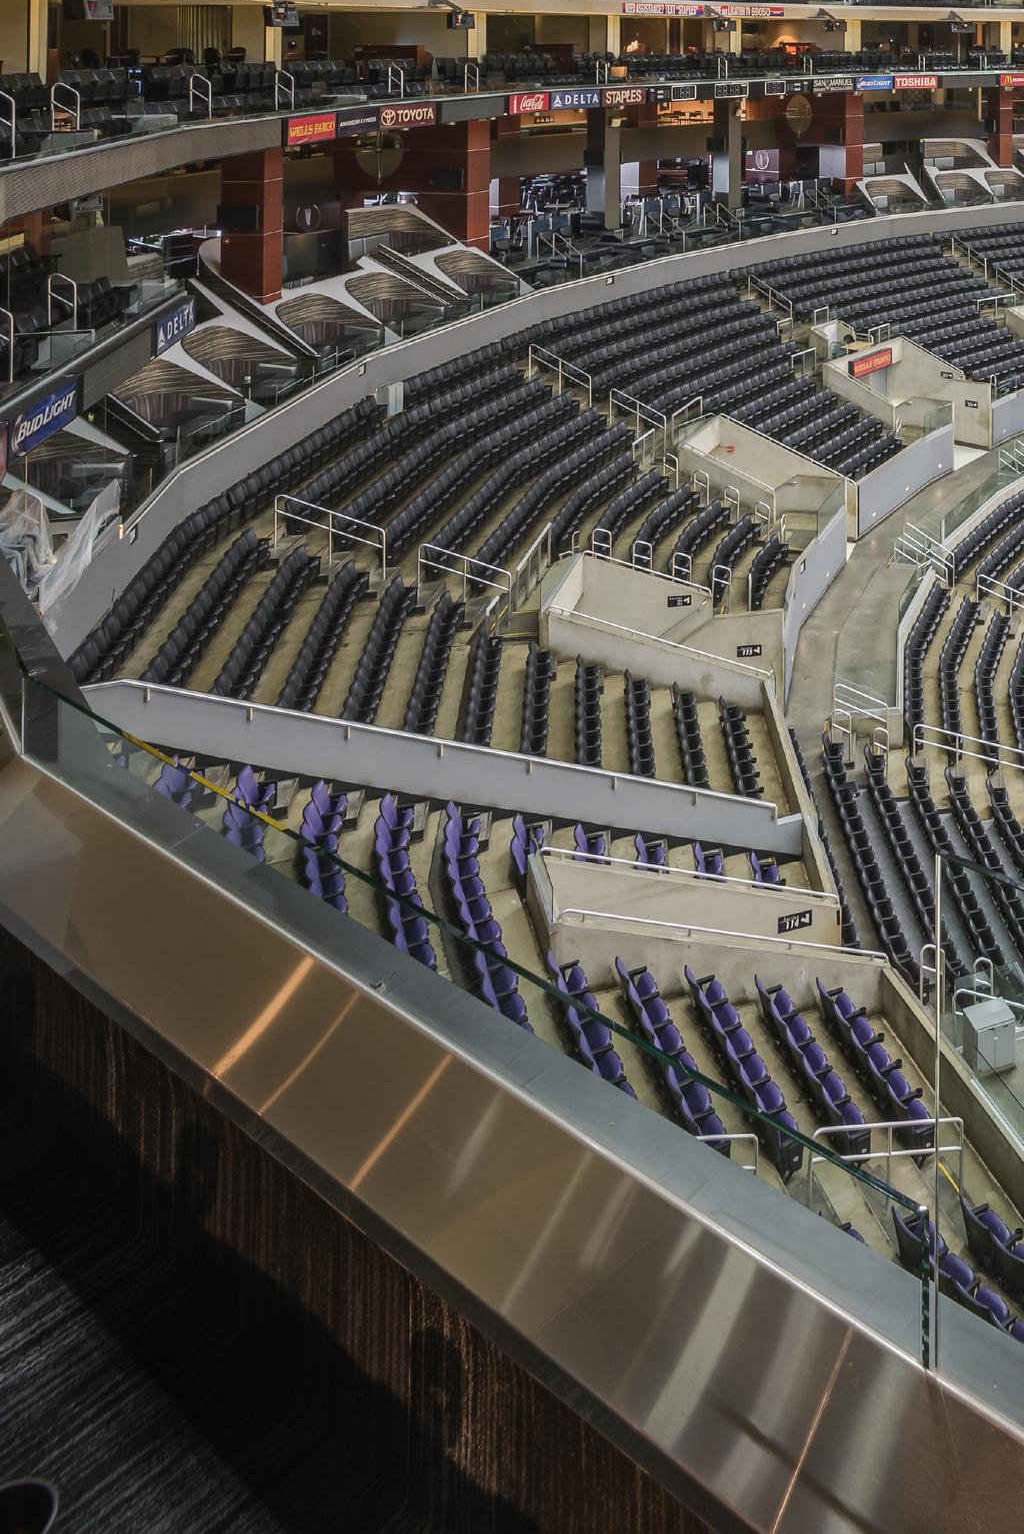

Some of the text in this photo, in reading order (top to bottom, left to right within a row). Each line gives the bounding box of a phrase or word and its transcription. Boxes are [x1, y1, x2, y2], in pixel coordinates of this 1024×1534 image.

[813, 79, 826, 87] SAN
[896, 77, 937, 86] TOSHIBA
[565, 93, 599, 106] DELTA
[605, 89, 642, 104] STAPLES
[397, 107, 434, 123] TOYOTA
[289, 121, 336, 138] WELLS FARGO
[167, 300, 195, 339] DELTA
[16, 390, 76, 444] BUD LIGHT
[785, 919, 800, 930] 114
